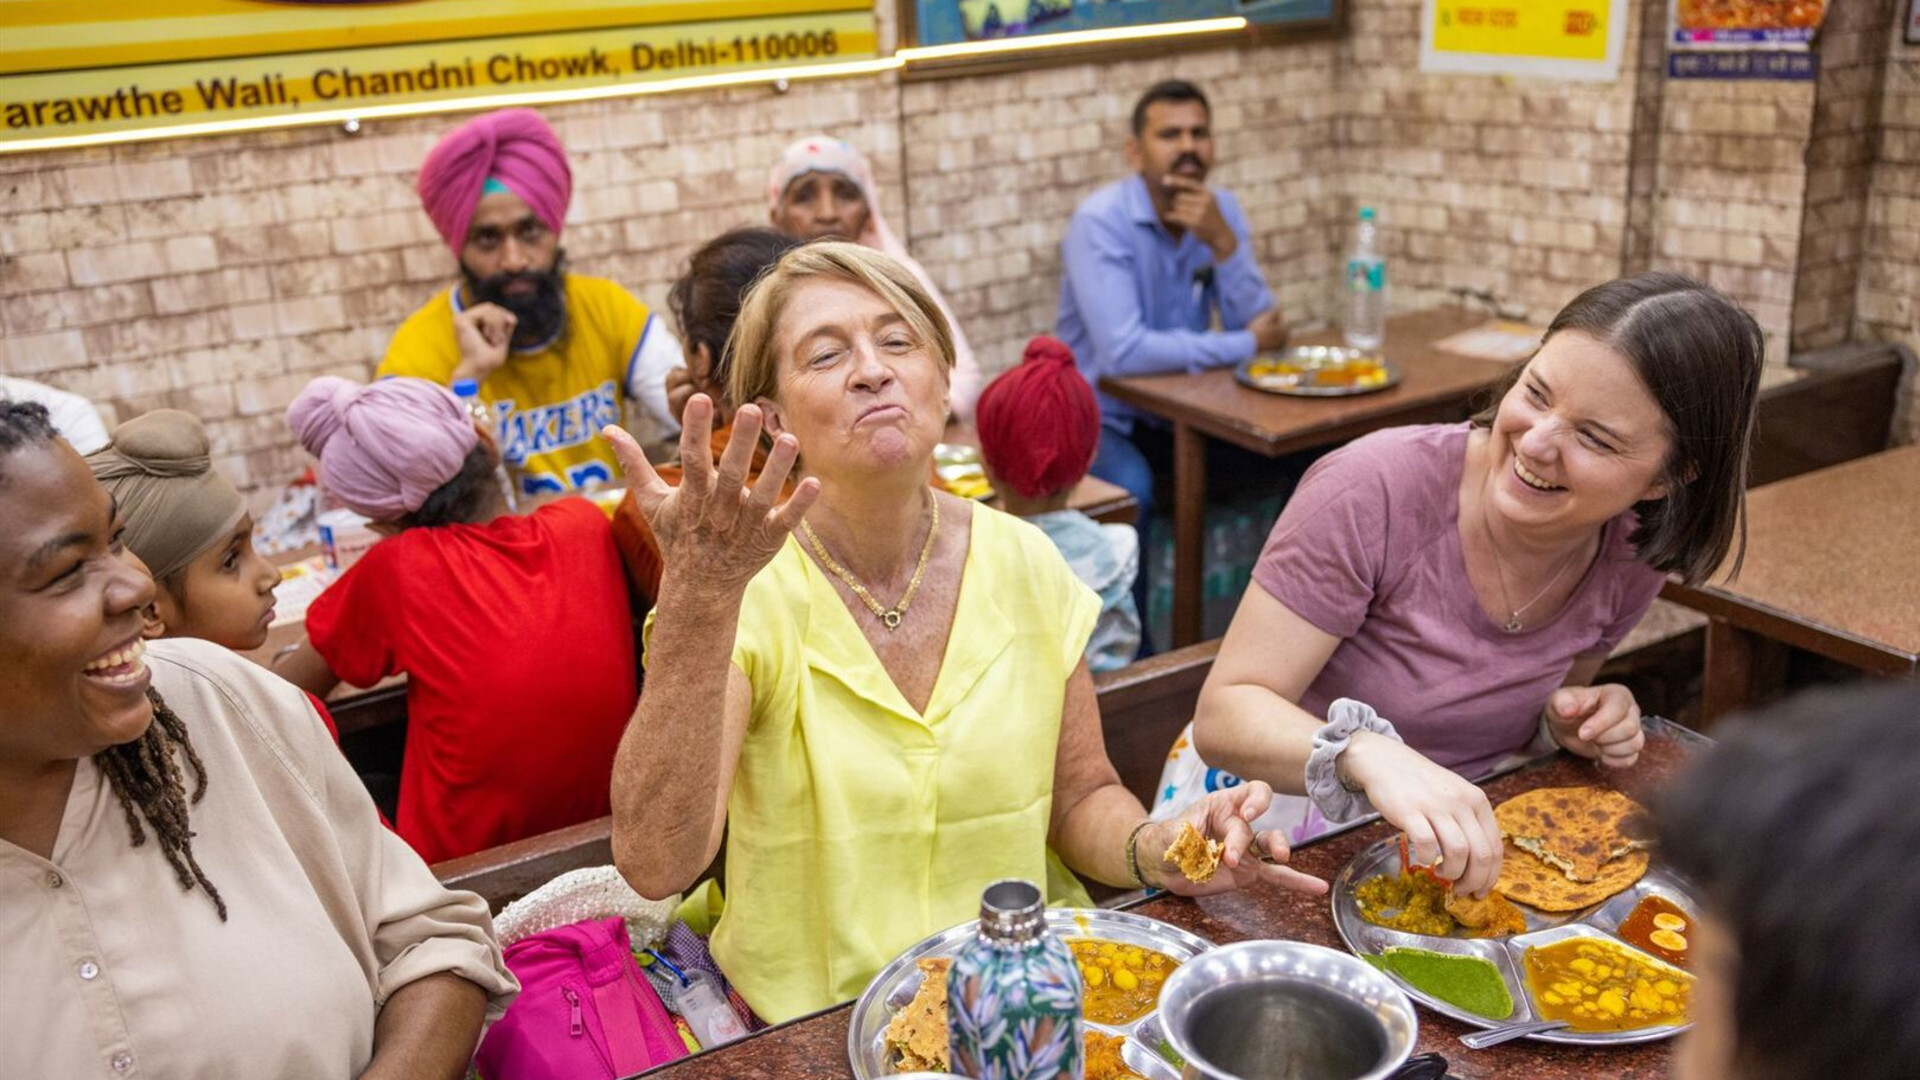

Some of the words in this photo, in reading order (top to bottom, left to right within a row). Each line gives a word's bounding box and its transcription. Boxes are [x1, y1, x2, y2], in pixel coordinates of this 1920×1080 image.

[195, 74, 299, 110] Wali,
[312, 57, 476, 100] Chandni
[487, 48, 622, 85] Chowk,
[630, 30, 839, 72] Delhi-110006
